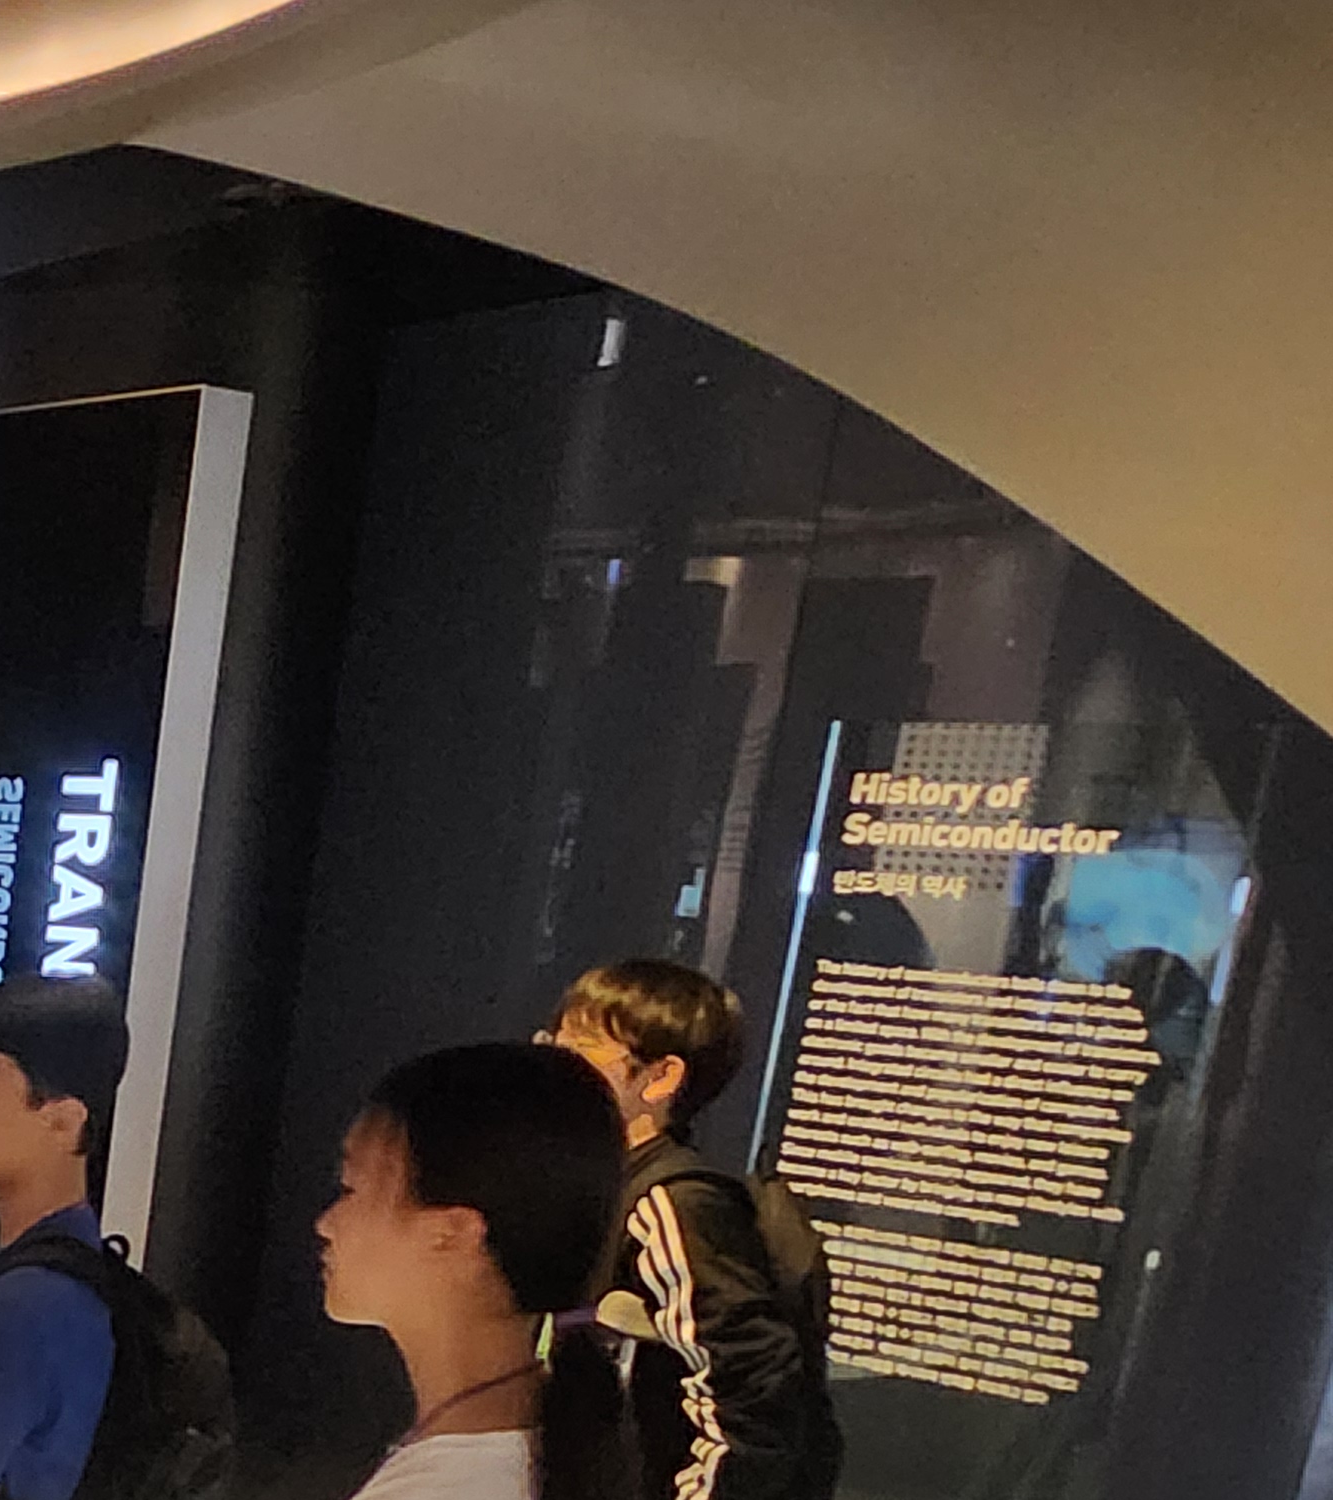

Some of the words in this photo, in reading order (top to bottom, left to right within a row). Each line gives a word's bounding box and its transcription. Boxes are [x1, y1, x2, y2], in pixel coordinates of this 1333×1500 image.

[849, 772, 982, 813] History
[986, 777, 1031, 808] of
[841, 811, 1120, 853] Semiconductor
[921, 874, 968, 899] 역사
